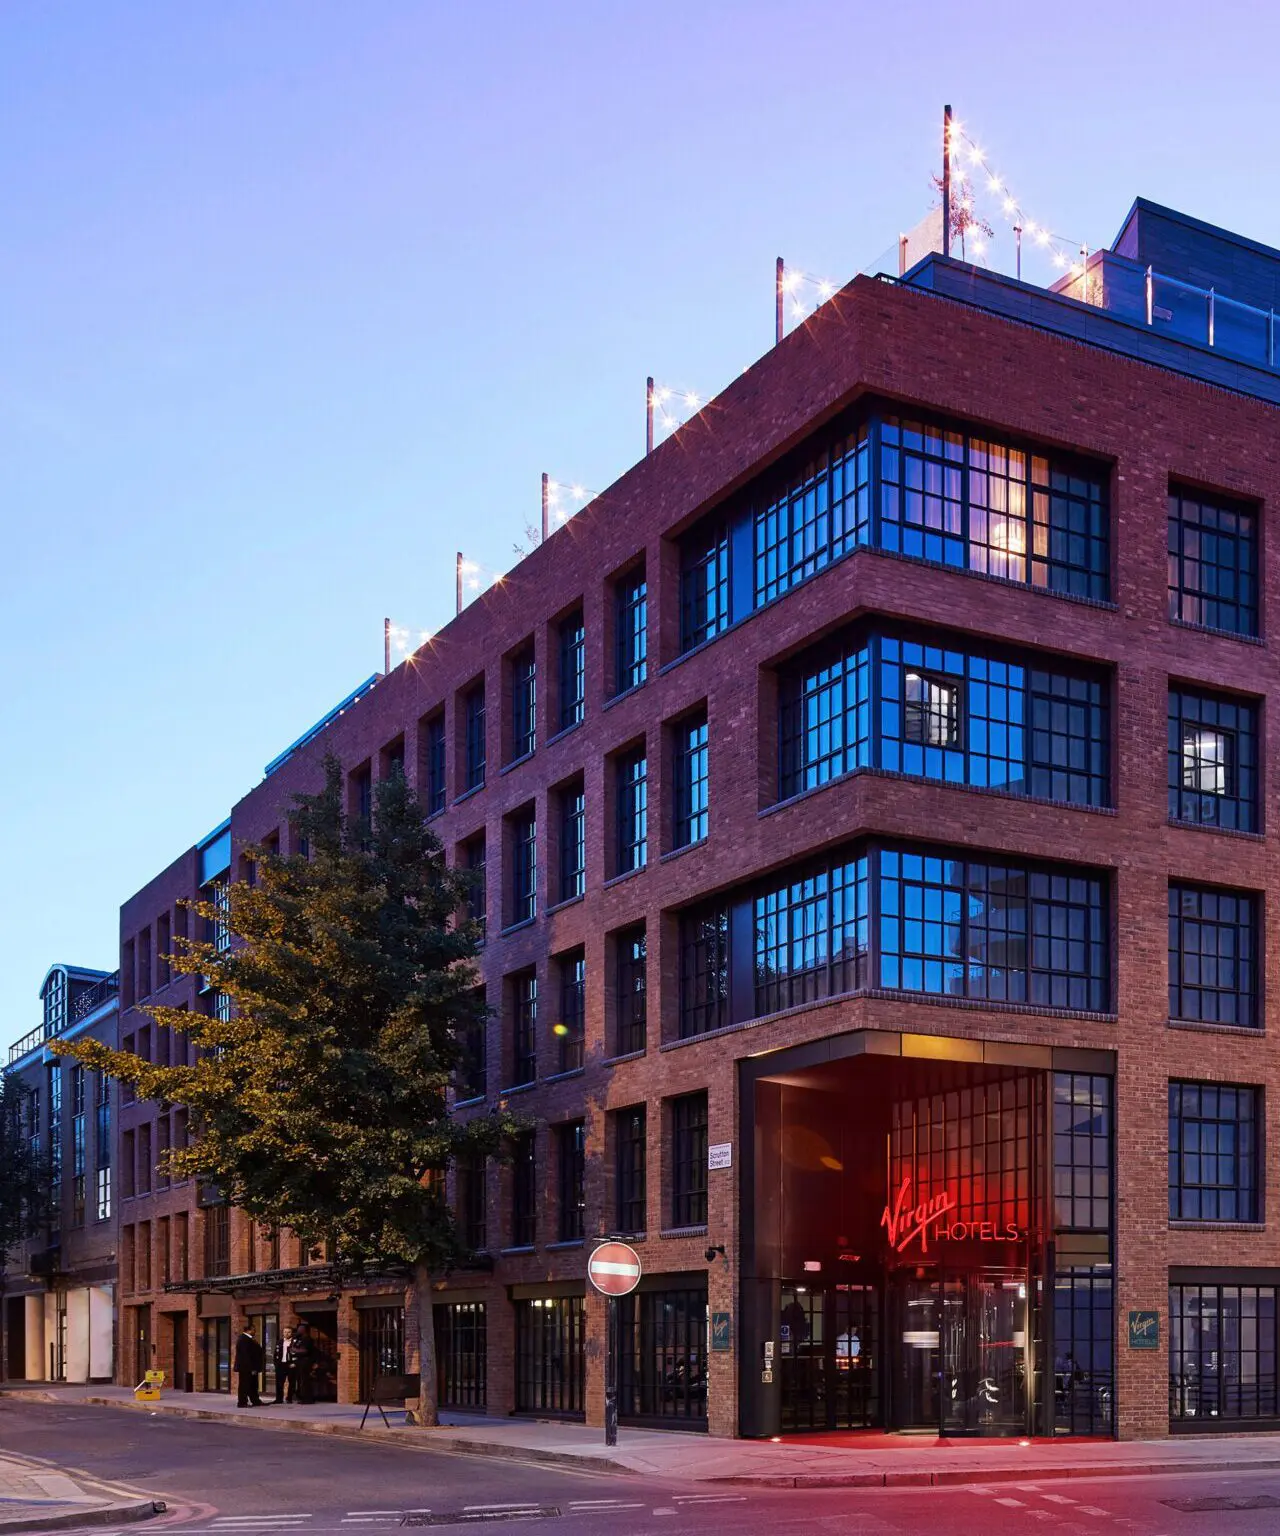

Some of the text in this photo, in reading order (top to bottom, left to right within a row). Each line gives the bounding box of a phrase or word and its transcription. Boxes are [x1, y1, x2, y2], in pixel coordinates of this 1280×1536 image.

[710, 1151, 729, 1160] Scrutton
[710, 1159, 724, 1168] Street
[880, 1177, 956, 1253] Virgin
[935, 1221, 1018, 1241] HOTELS
[1130, 1313, 1156, 1336] Virgin
